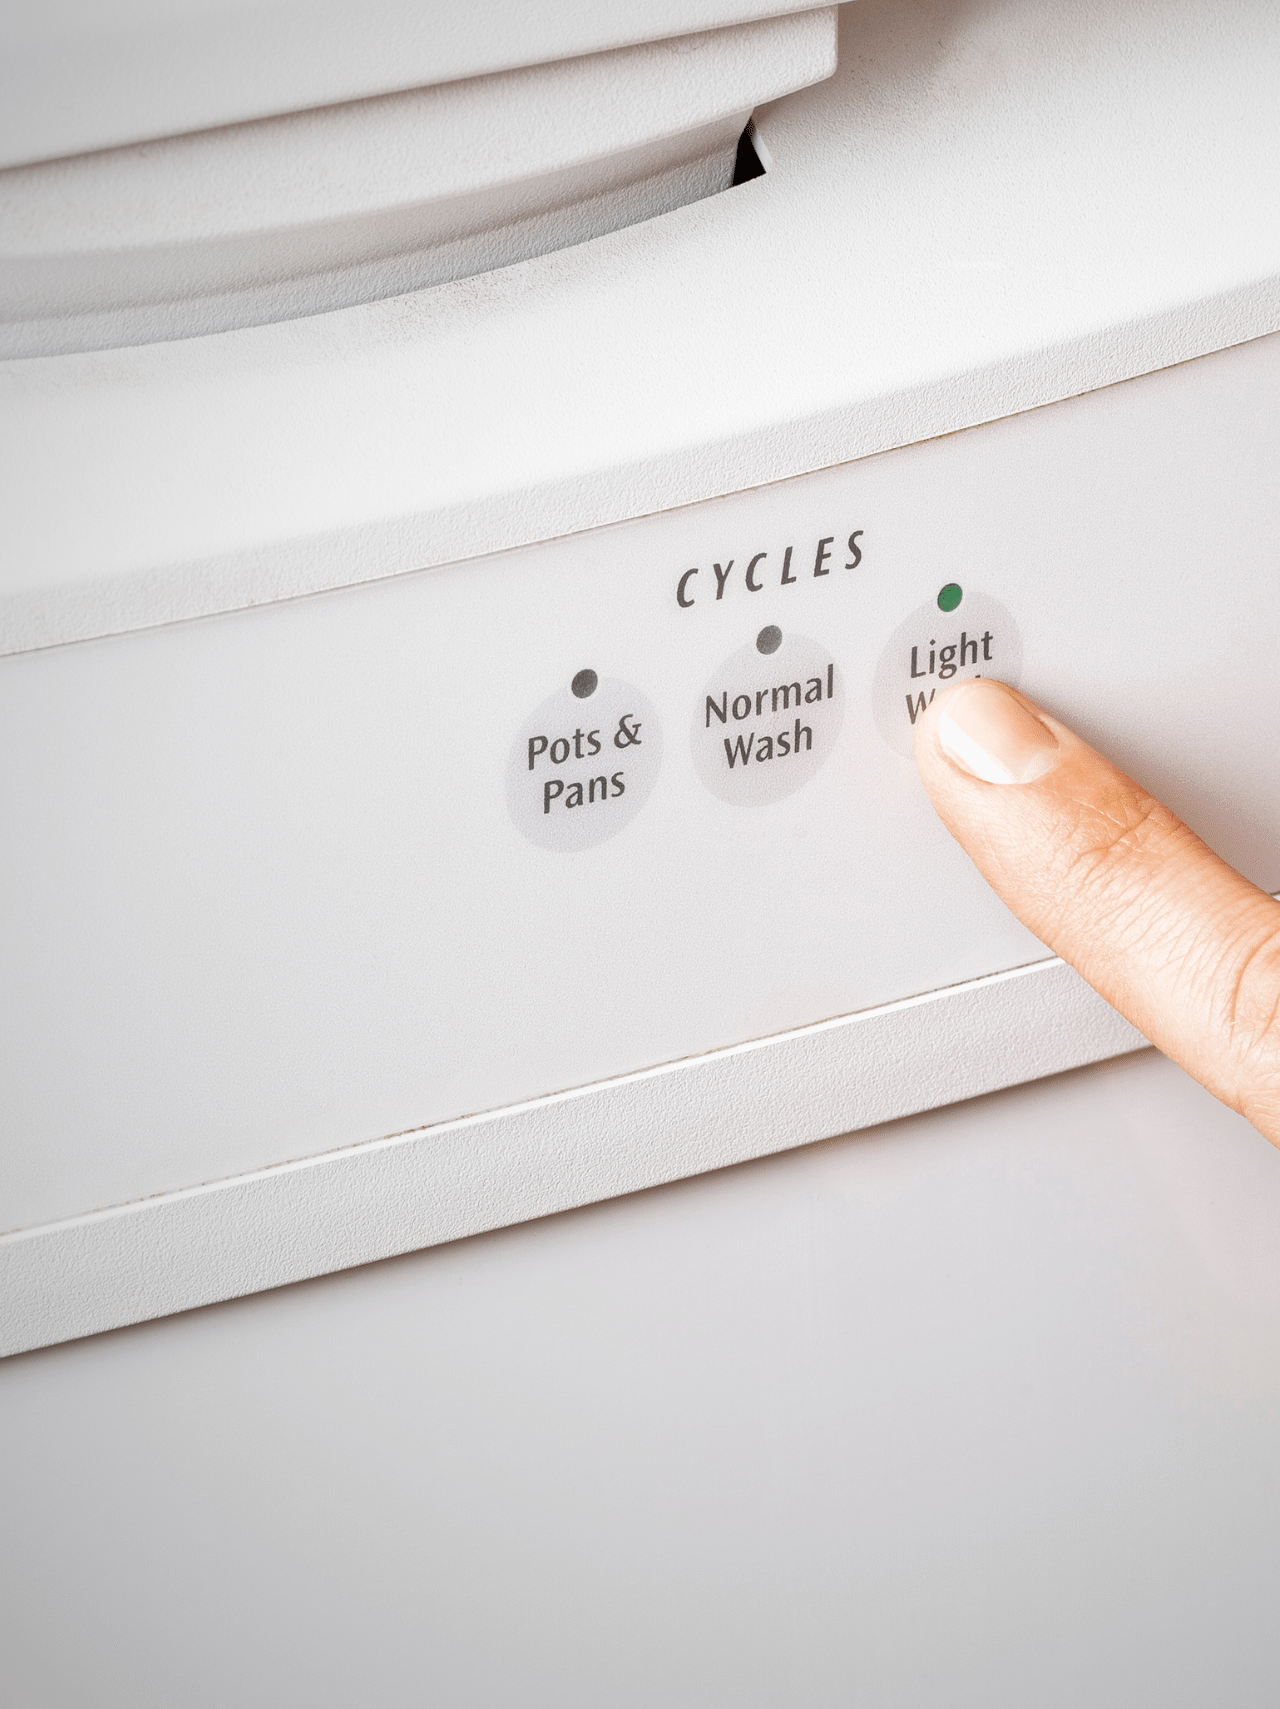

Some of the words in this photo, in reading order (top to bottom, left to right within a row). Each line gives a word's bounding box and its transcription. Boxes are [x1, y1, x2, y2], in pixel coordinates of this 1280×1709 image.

[676, 529, 866, 609] CYCLES
[909, 630, 994, 680] Light
[704, 663, 835, 729] Normal
[527, 725, 602, 771] Pots
[612, 712, 644, 750] &
[722, 718, 814, 770] Wash
[542, 770, 627, 815] Pans
